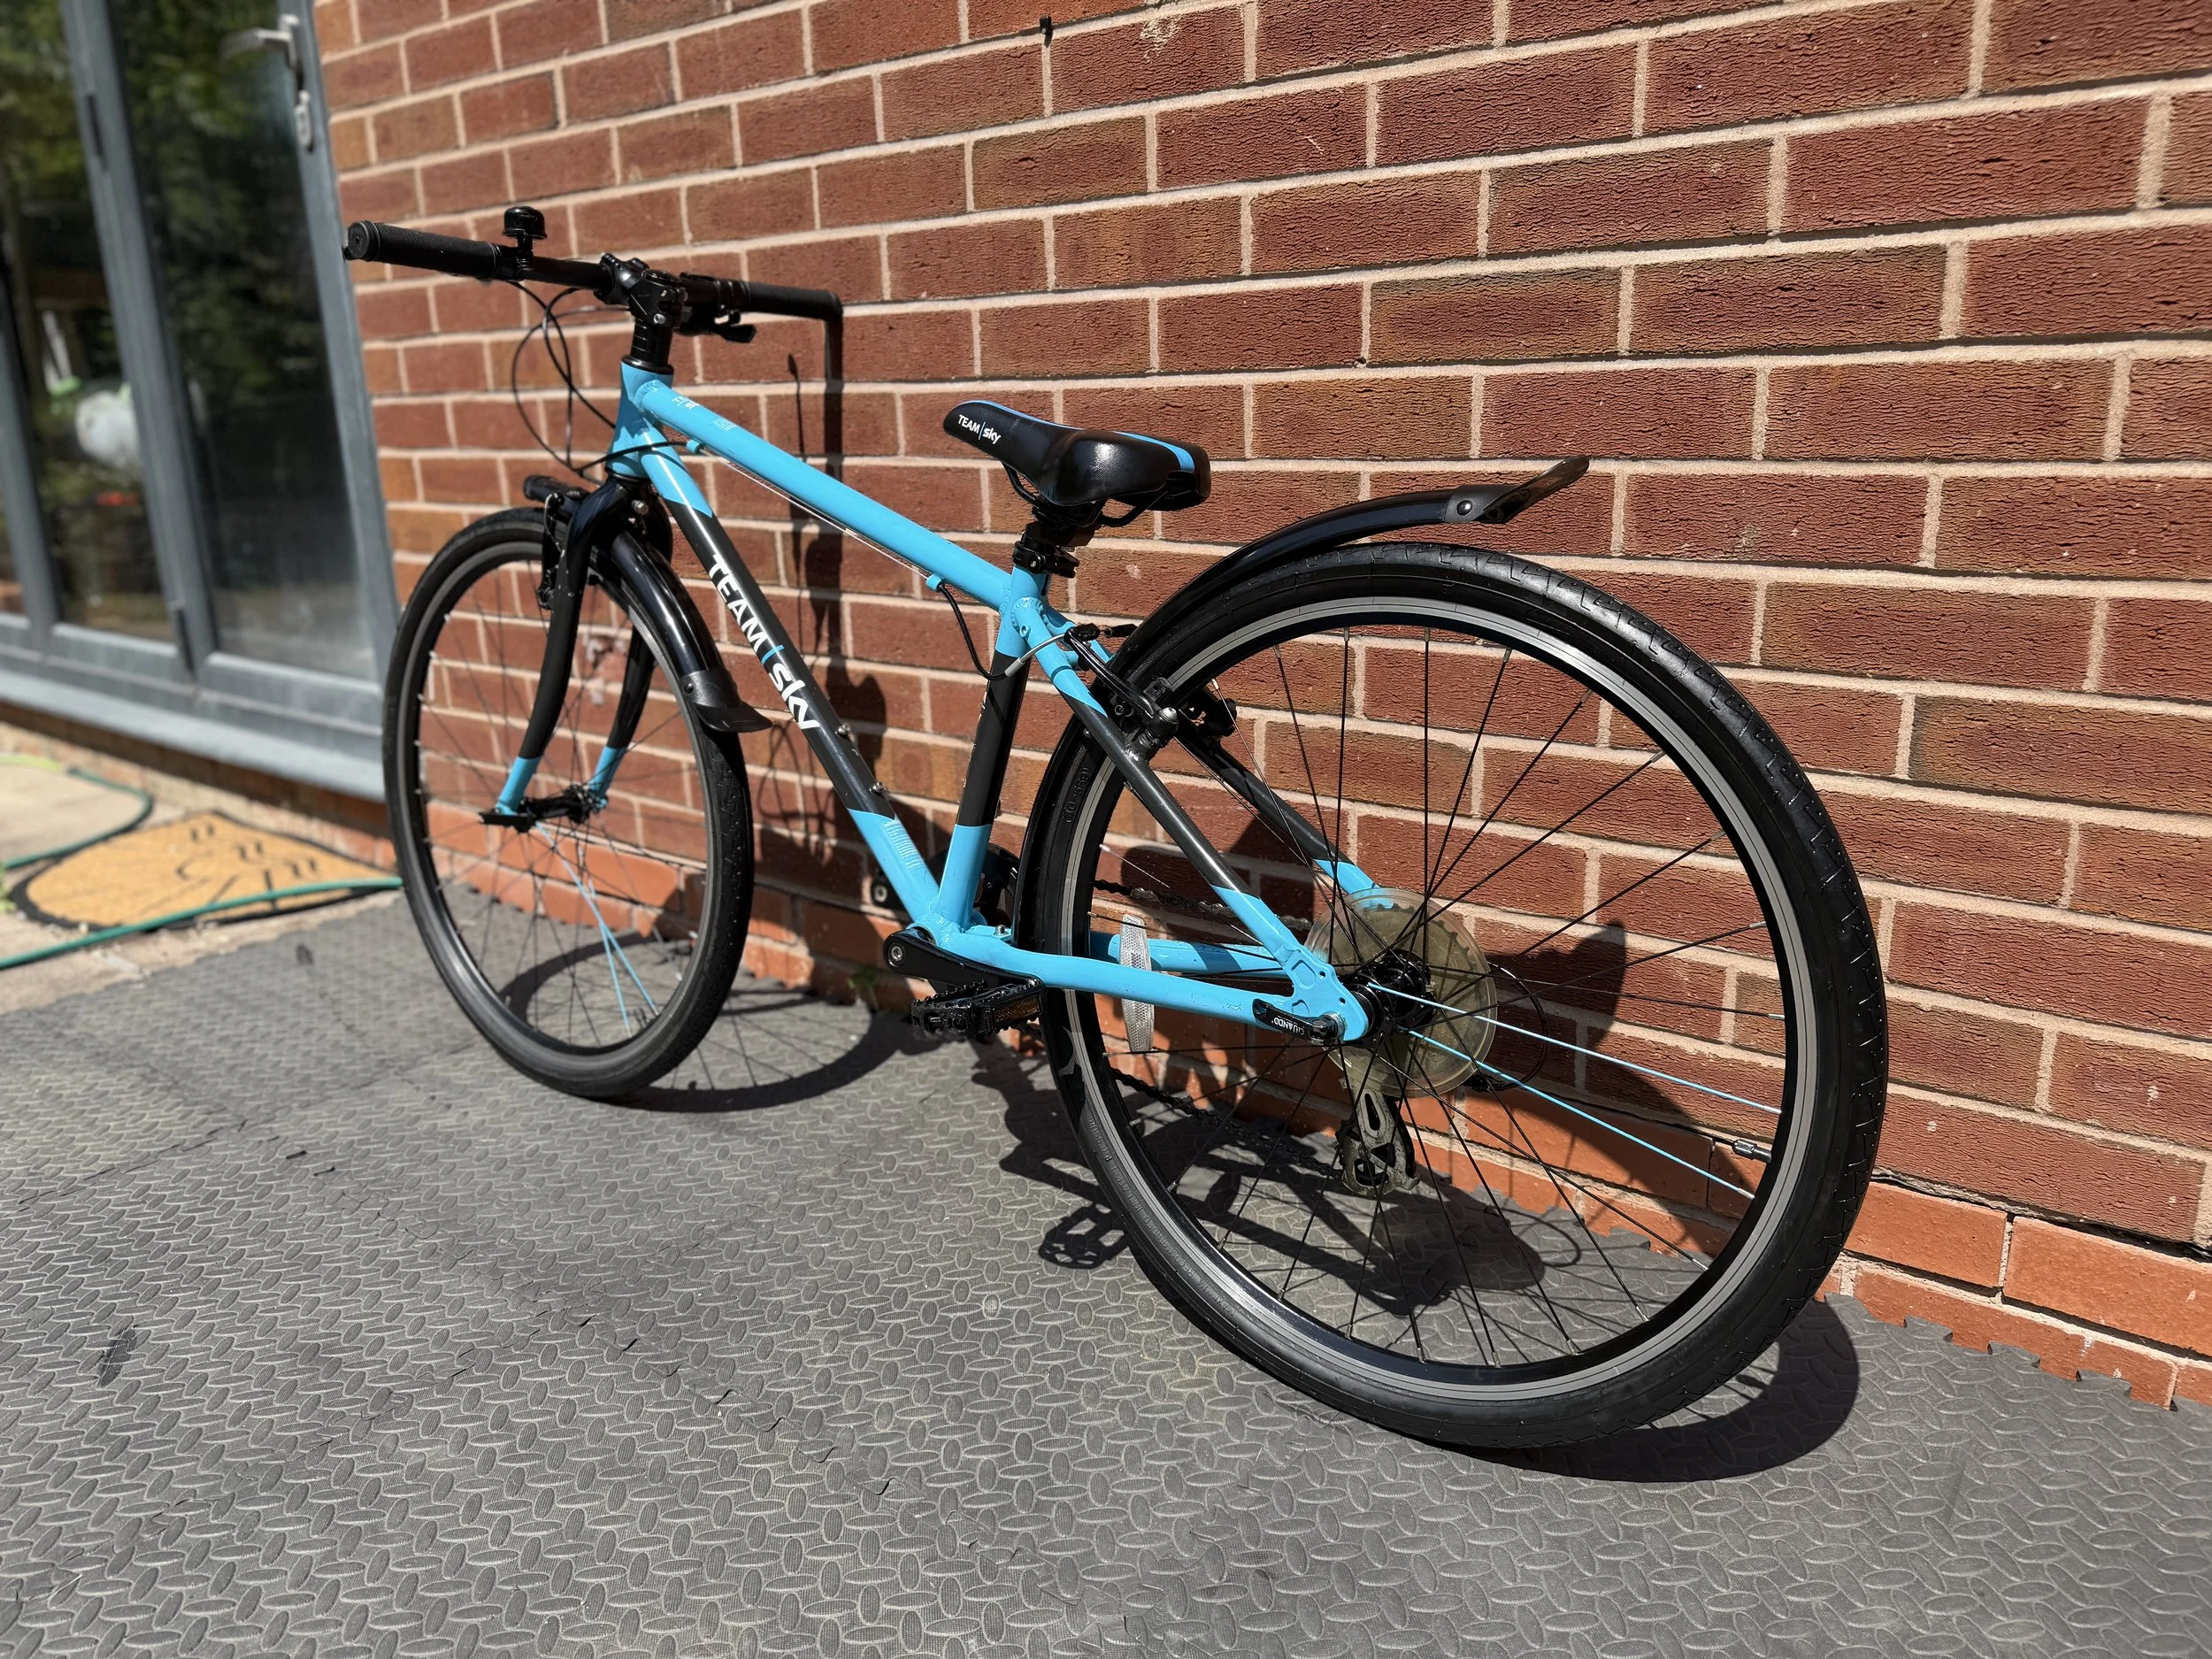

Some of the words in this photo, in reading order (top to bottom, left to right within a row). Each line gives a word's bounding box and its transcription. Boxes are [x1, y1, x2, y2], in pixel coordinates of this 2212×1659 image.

[957, 414, 980, 434] TEAM
[982, 427, 1002, 444] sky
[709, 552, 771, 655] TEAM
[769, 663, 820, 730] sky
[1274, 1017, 1305, 1035] QUANDO
[1110, 1165, 1144, 1213] INFLATION
[1143, 1216, 1195, 1278] RECOMMENDED
